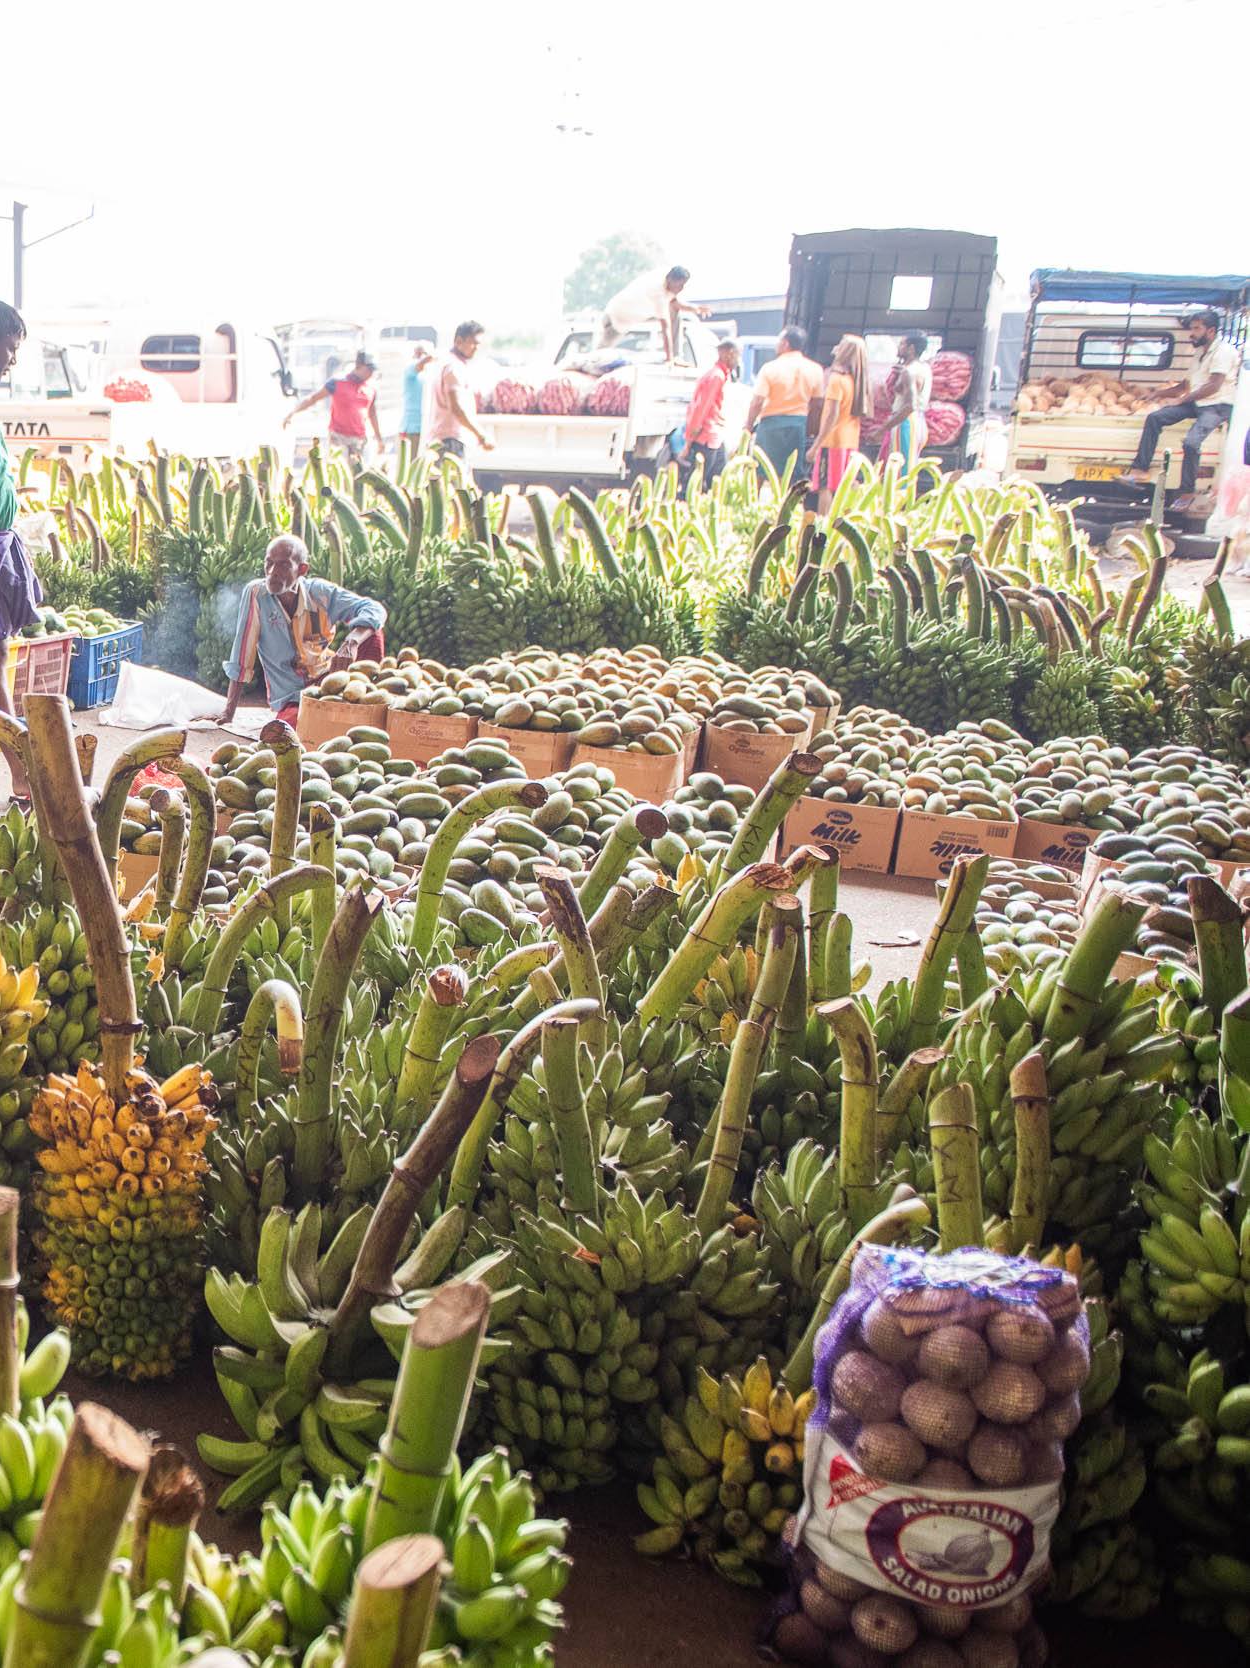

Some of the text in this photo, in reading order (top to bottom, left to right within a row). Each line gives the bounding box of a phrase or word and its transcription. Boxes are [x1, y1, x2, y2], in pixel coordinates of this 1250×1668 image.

[3, 422, 50, 436] TATA
[810, 823, 862, 845] Milk
[882, 1556, 1019, 1604] SALAD ONIONS
